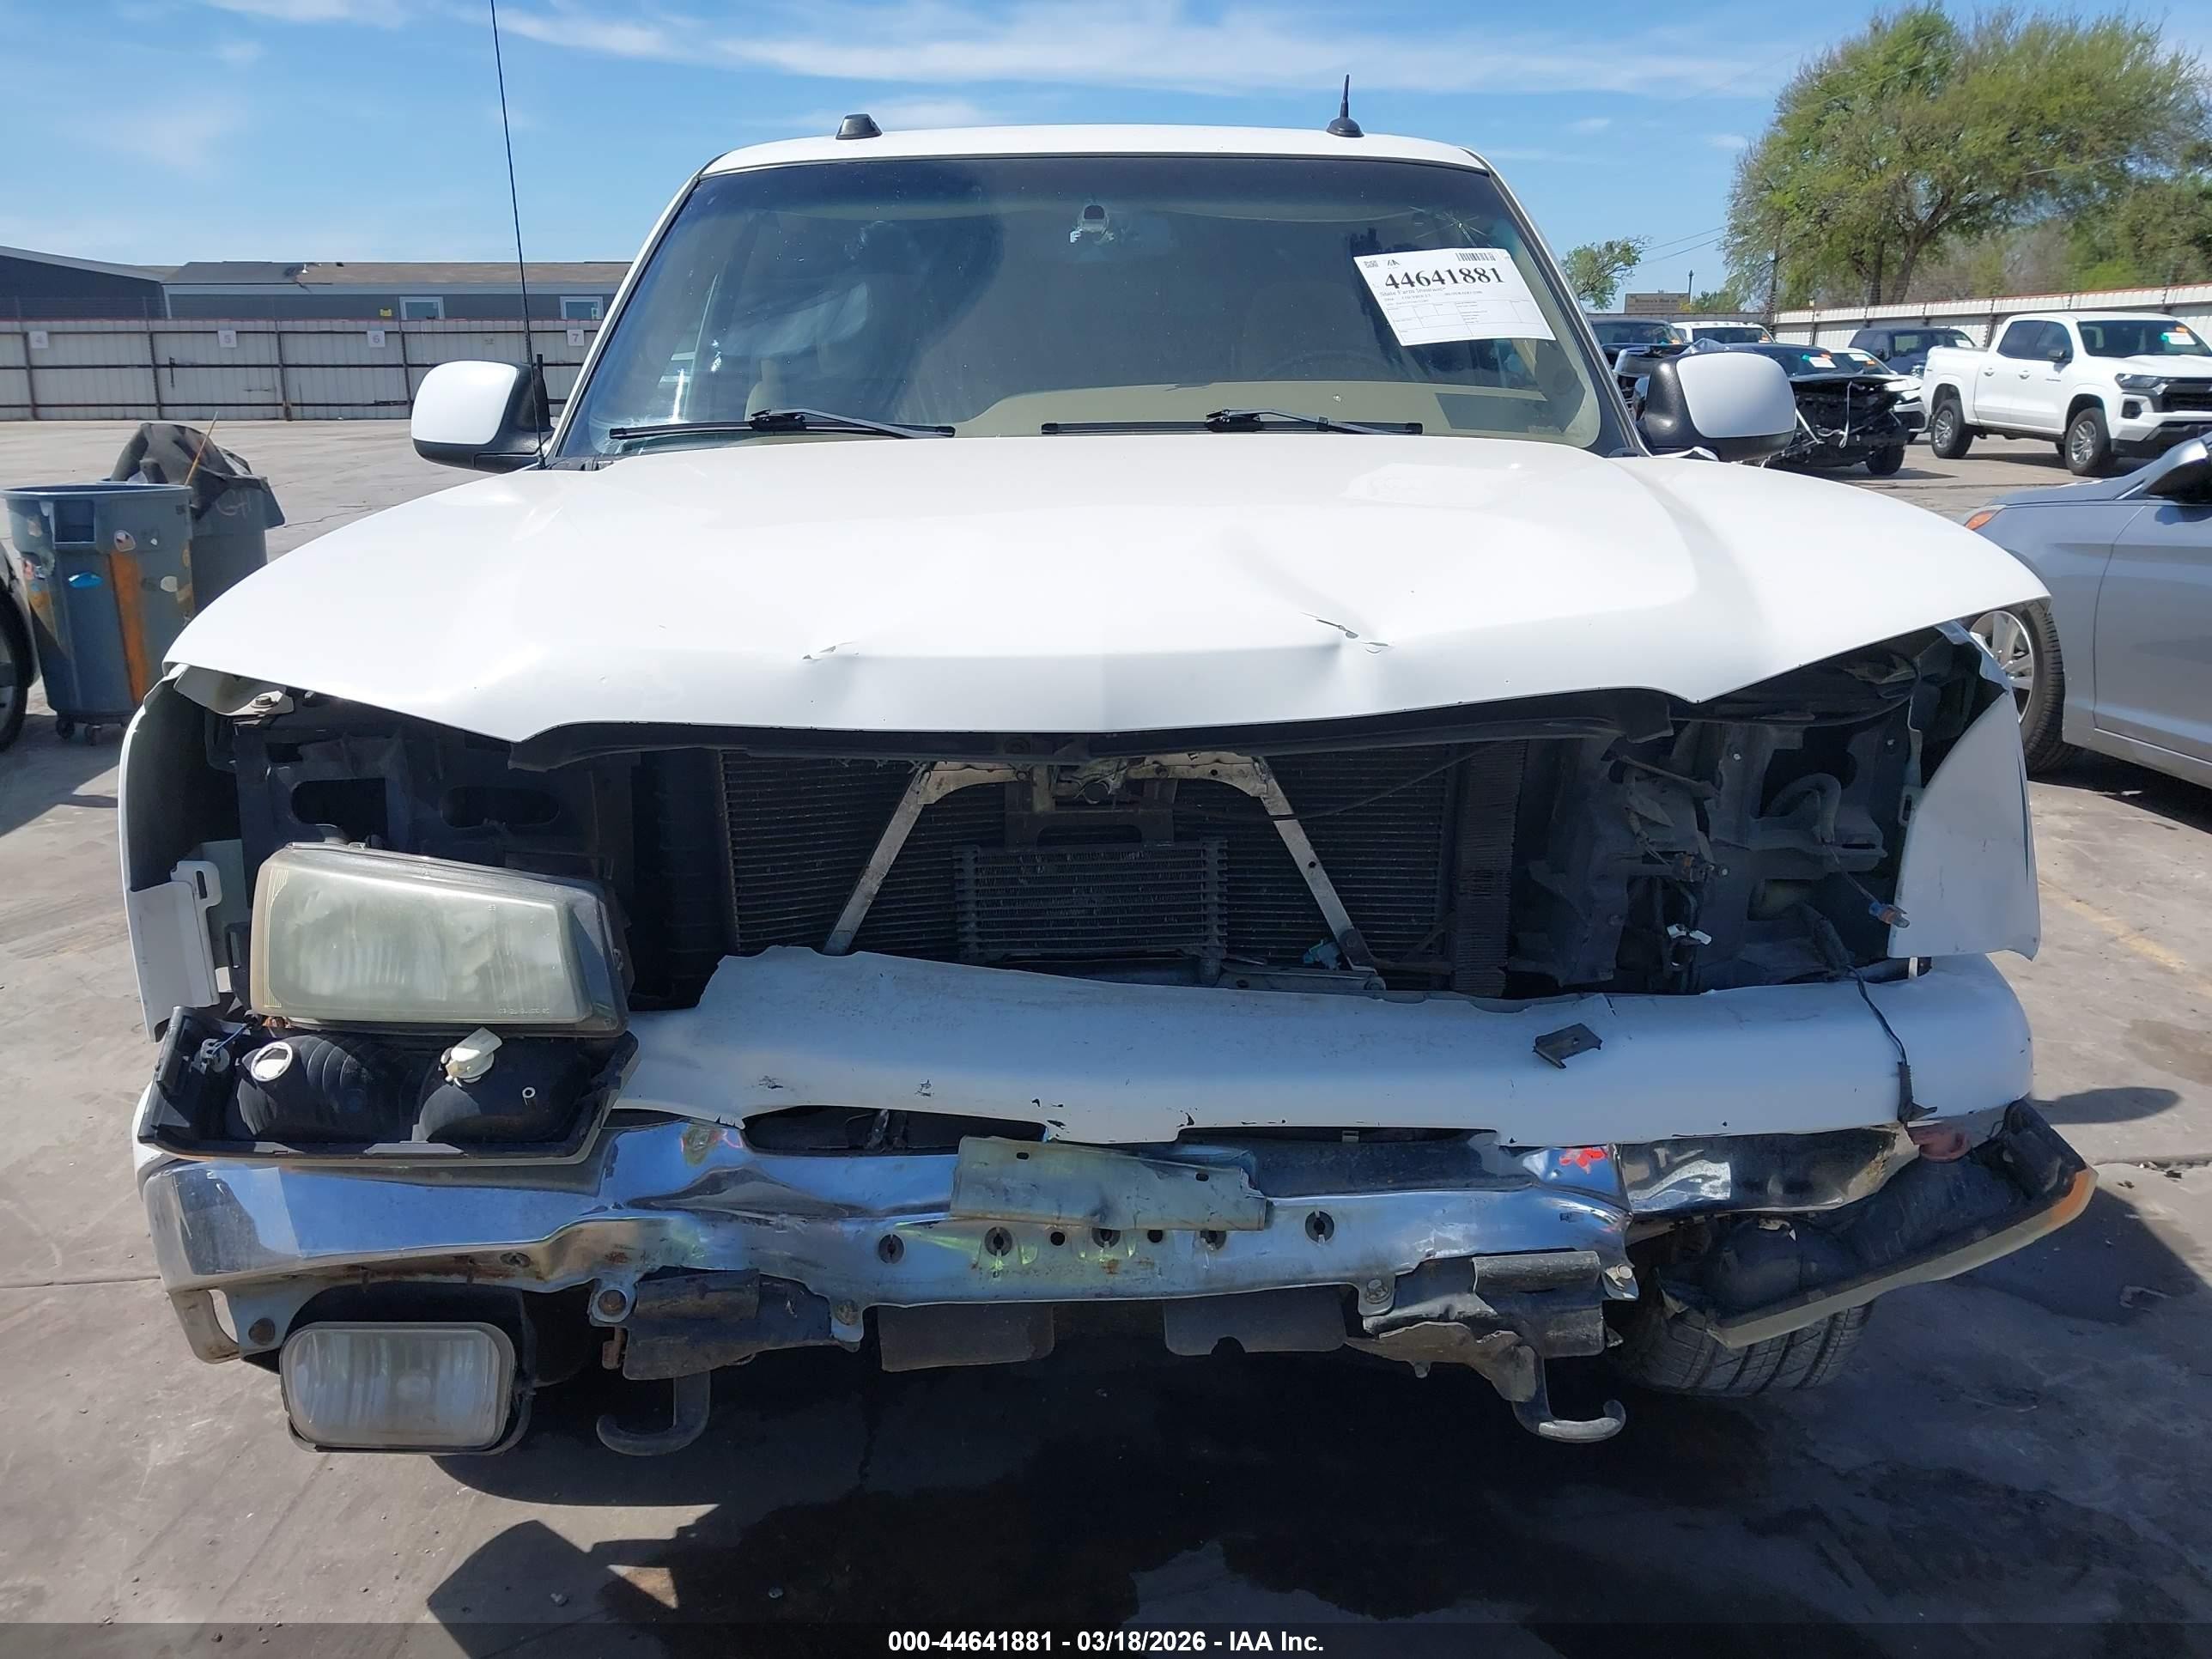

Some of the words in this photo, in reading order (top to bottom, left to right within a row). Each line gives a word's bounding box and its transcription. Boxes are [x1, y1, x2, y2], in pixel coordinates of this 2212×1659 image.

[1385, 267, 1505, 289] 44641881
[223, 335, 232, 344] 5
[372, 335, 380, 343] 6
[572, 333, 579, 343] 7
